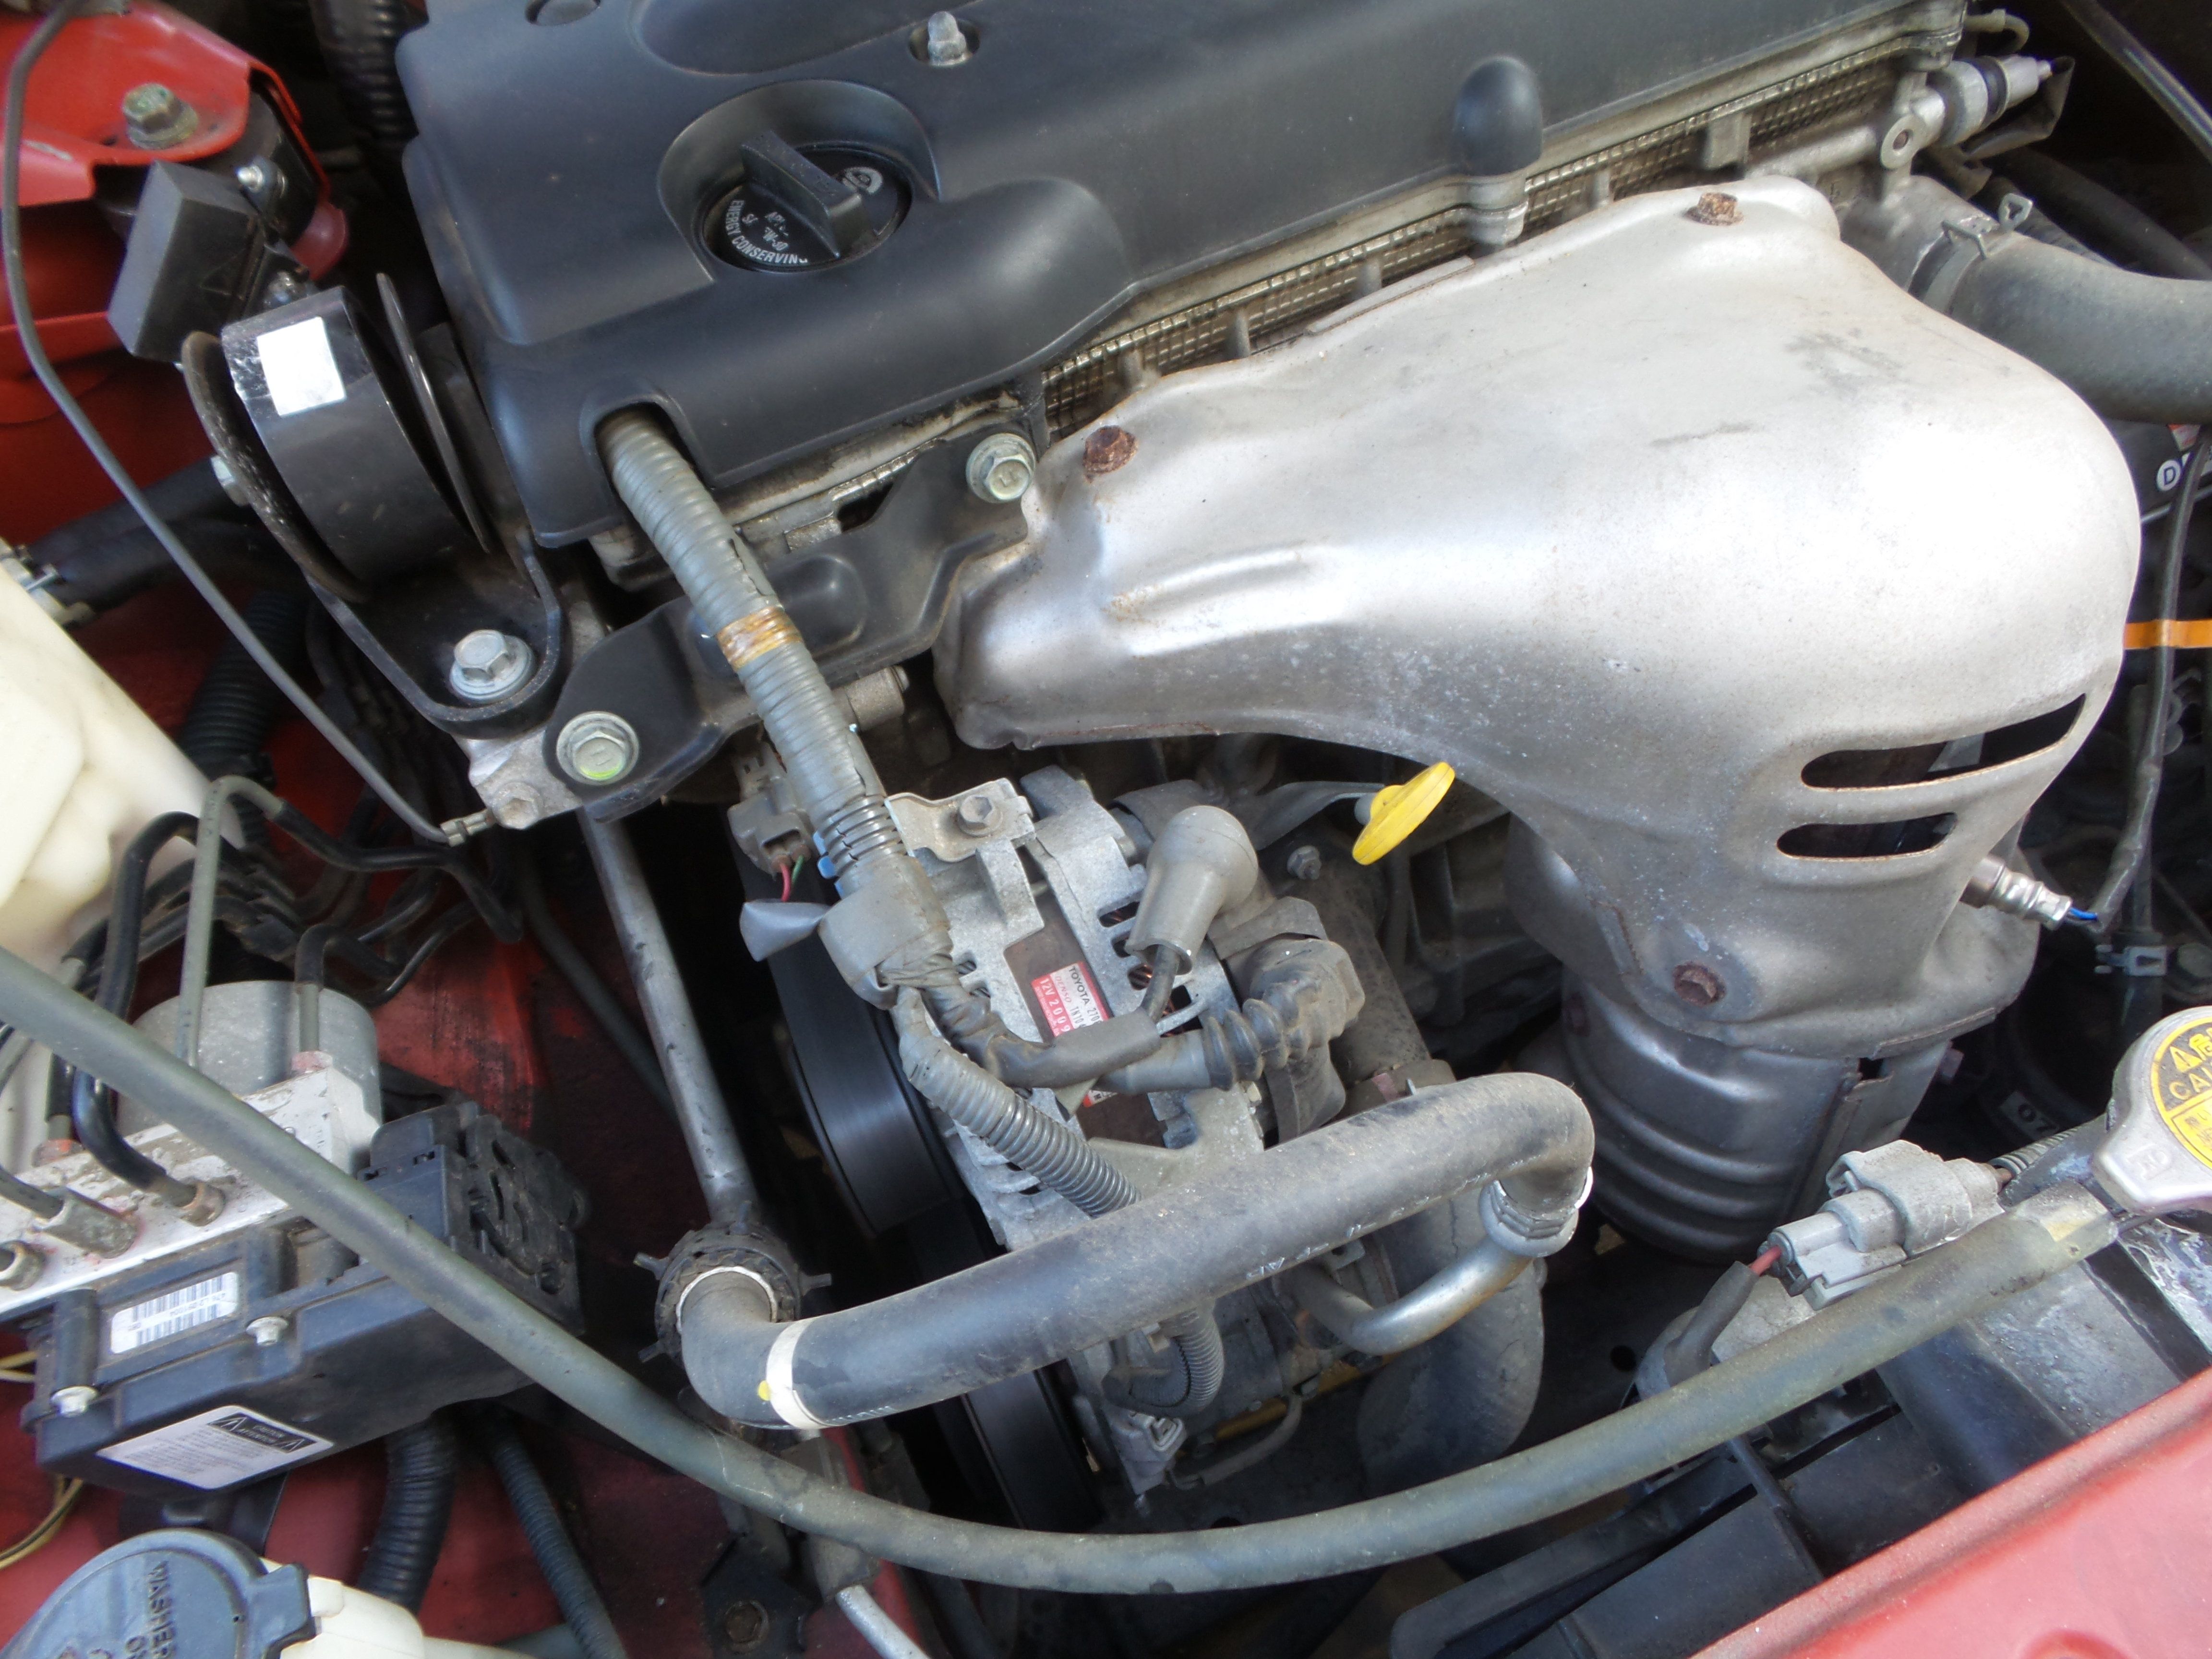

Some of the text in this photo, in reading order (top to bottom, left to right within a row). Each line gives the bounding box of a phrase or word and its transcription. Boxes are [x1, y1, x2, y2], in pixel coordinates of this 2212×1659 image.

[725, 200, 745, 236] ENERGY
[1039, 978, 1056, 996] 12V
[1056, 975, 1072, 1003] DENSO
[1069, 966, 1090, 1005] TOYOTA
